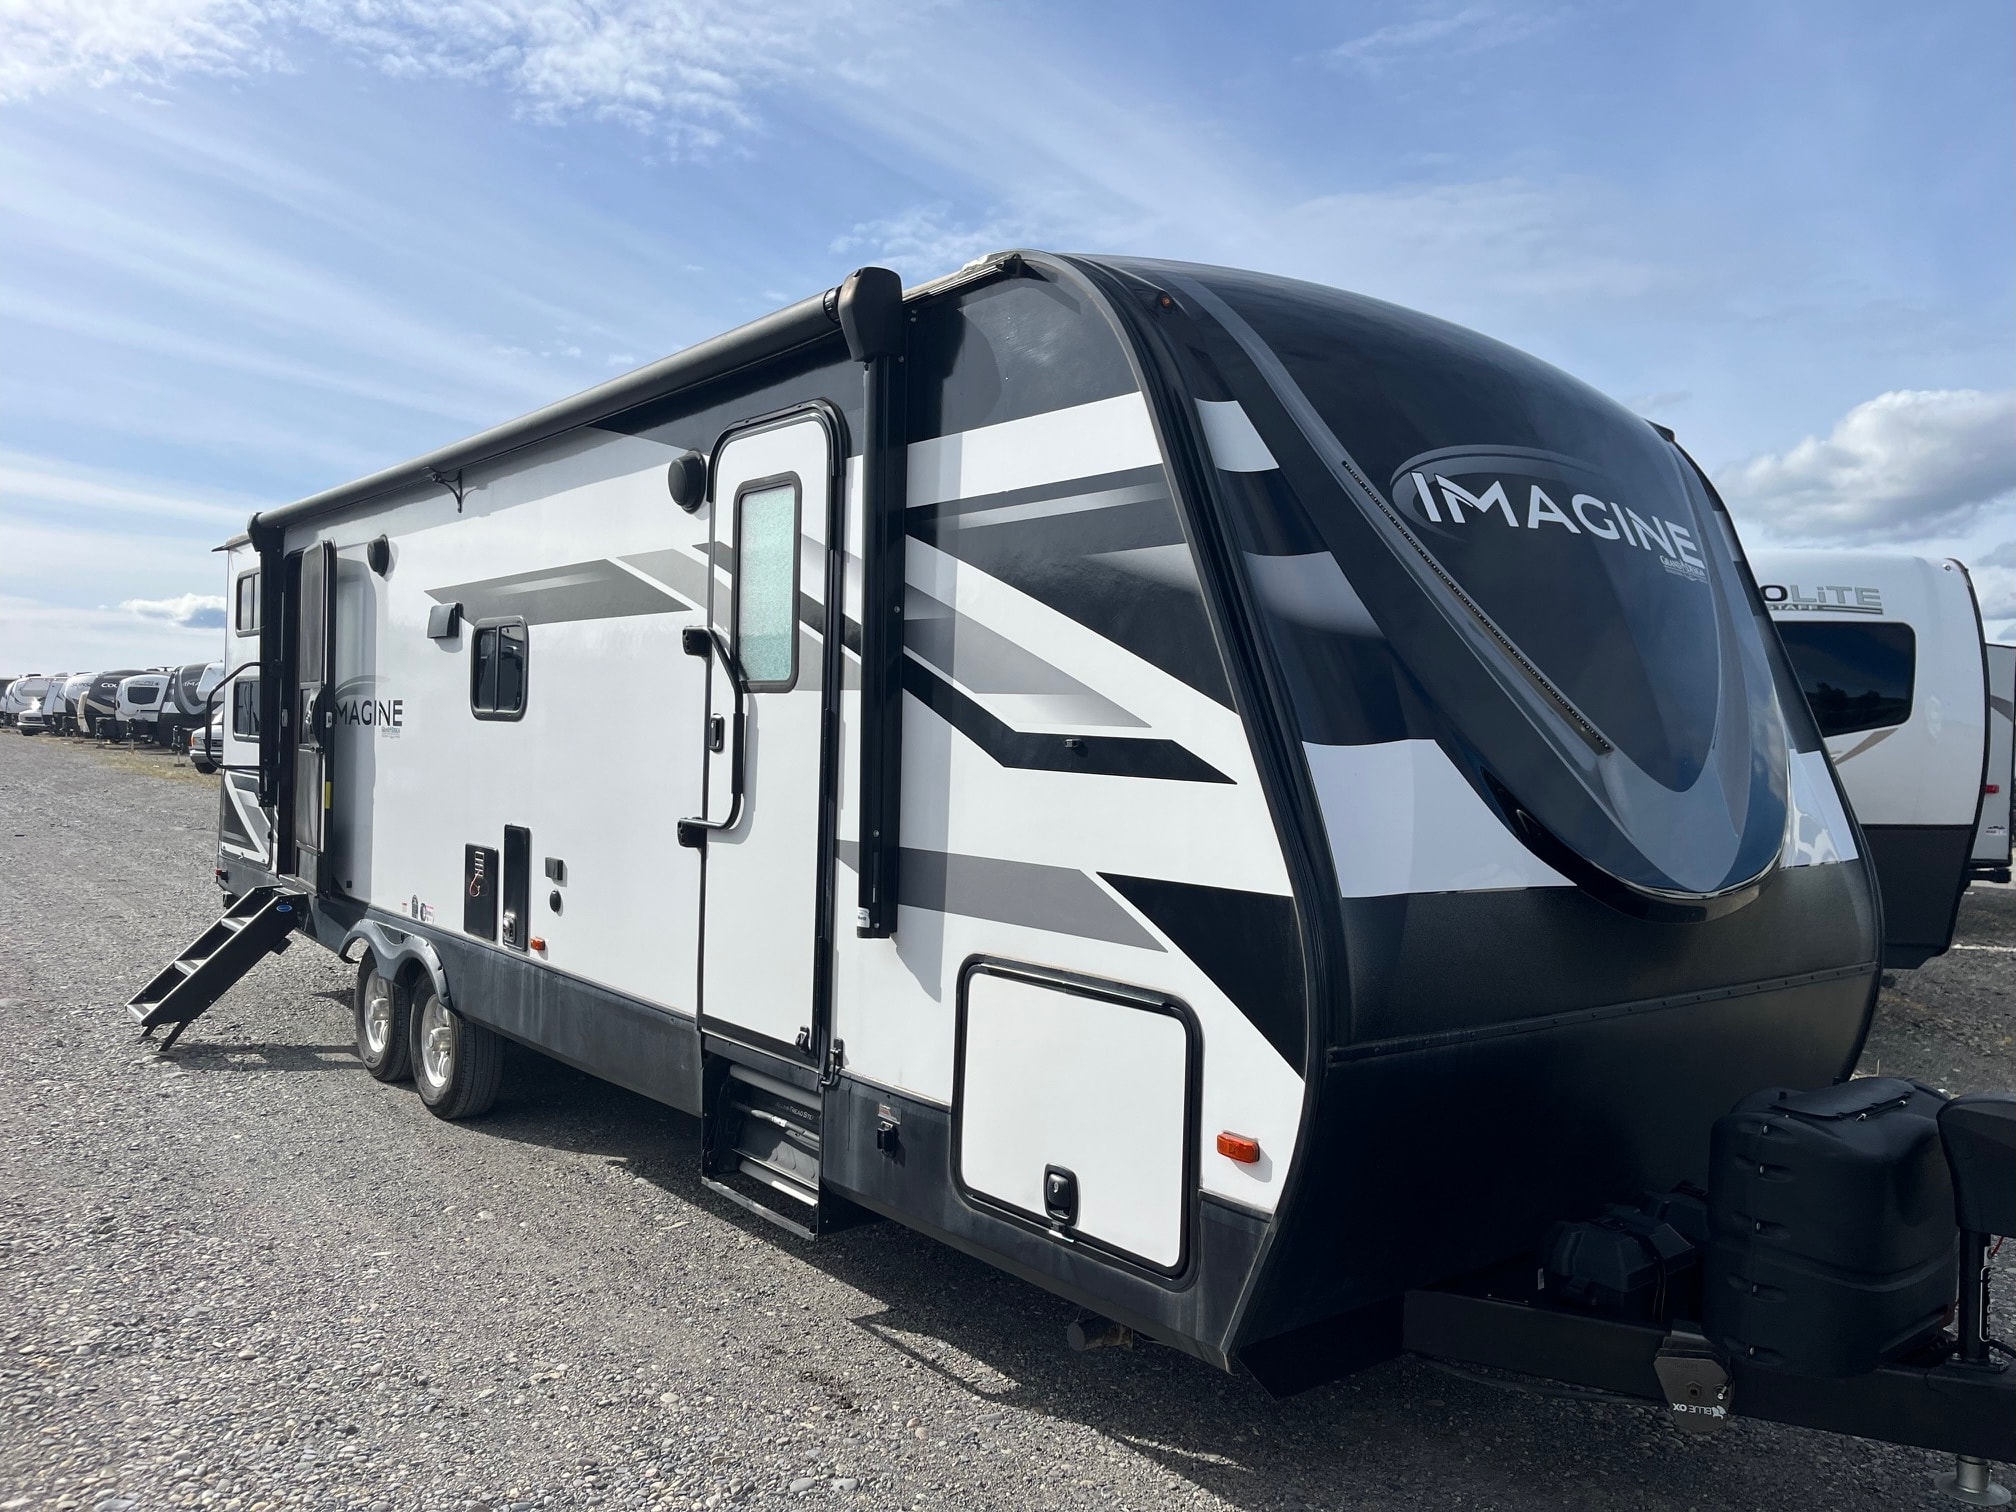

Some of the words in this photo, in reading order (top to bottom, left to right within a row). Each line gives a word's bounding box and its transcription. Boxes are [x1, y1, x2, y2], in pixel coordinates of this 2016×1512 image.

[1411, 472, 1705, 569] IMAGINE
[334, 700, 403, 727] MAGINE
[1672, 1402, 1688, 1412] OX
[1688, 1404, 1712, 1415] BLUE
